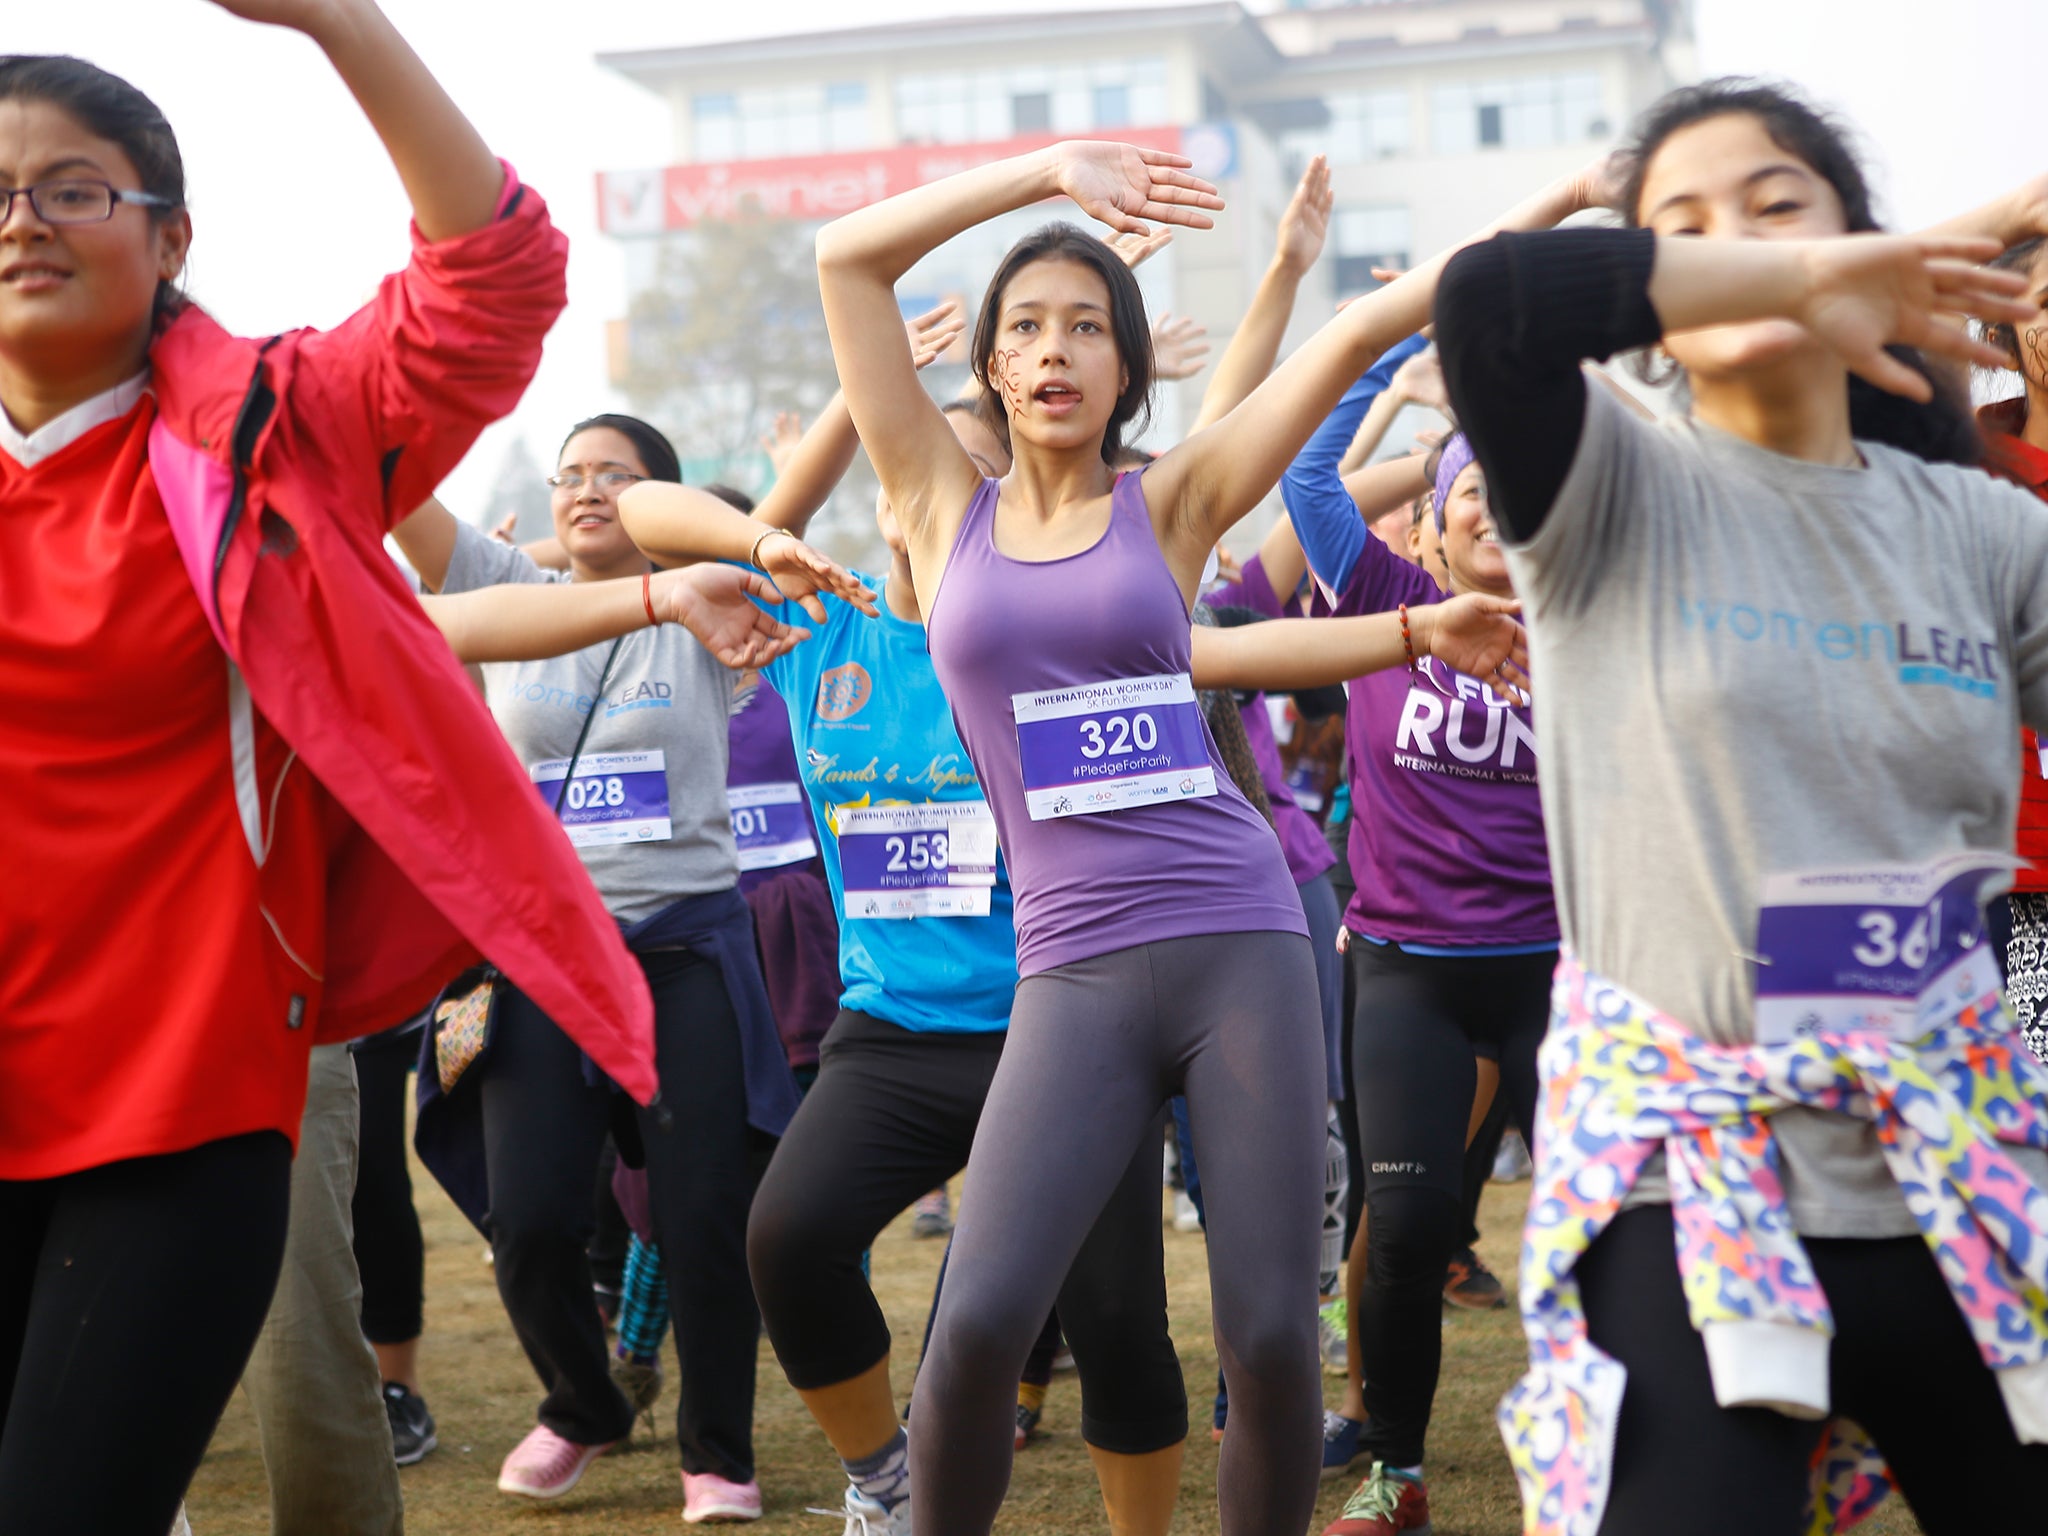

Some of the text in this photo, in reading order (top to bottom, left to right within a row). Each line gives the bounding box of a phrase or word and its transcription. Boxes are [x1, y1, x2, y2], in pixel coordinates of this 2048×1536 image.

[510, 680, 672, 714] womeLEAD
[1034, 681, 1173, 707] INTERNATIONAL WOMEN'S DAY
[1087, 694, 1141, 709] 5K Fun Run
[1079, 712, 1158, 759] 320
[1395, 688, 1538, 768] RUN
[1073, 754, 1171, 778] #PledgeForParity
[1394, 753, 1497, 780] INTERNATIONAL
[566, 777, 625, 810] 028
[730, 807, 768, 836] 01
[851, 810, 915, 821] INTERNATIONAL
[885, 832, 949, 873] 253
[1371, 1162, 1413, 1173] CRAFT
